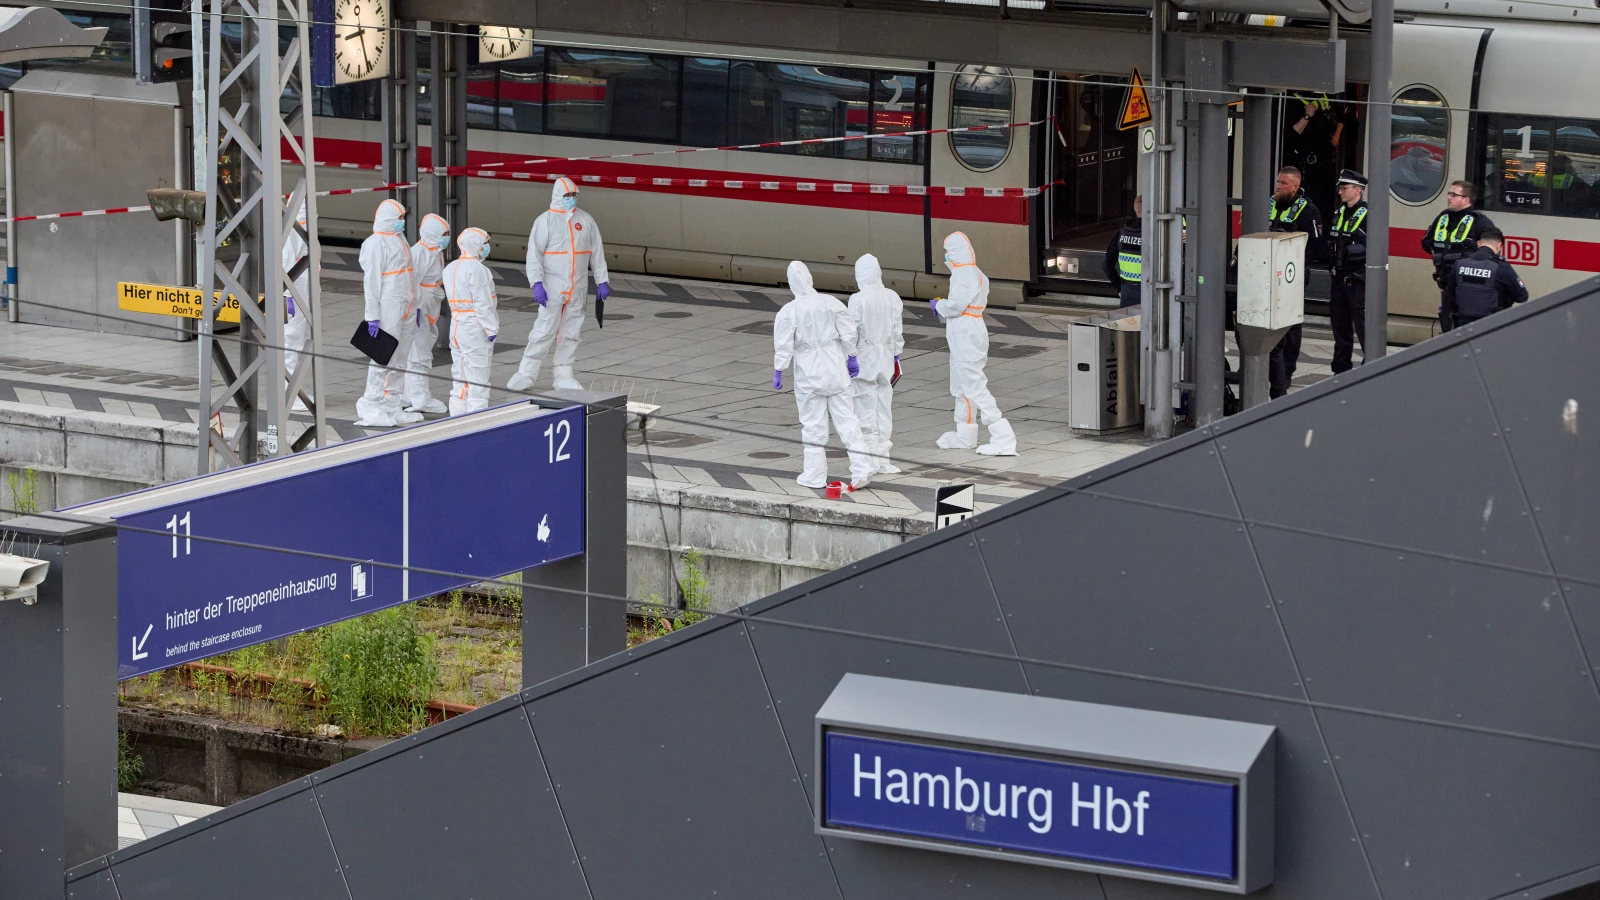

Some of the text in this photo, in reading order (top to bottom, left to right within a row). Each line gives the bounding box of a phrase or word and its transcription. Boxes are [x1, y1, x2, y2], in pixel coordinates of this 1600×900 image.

[880, 74, 903, 112] 2
[1516, 125, 1535, 159] 1
[1119, 235, 1142, 246] POLIZE
[1507, 241, 1535, 261] DB
[1458, 266, 1492, 279] POLIZEI
[124, 284, 152, 300] Hier
[156, 288, 190, 304] nicht
[172, 305, 193, 315] Don't
[1106, 357, 1118, 416] Abfall
[543, 419, 571, 464] 12
[166, 511, 190, 559] 11
[166, 572, 337, 630] hinter der Treppeneinhausung
[165, 623, 263, 658] behind the staircase enclosure
[853, 753, 1150, 836] Hamburg Hbf
